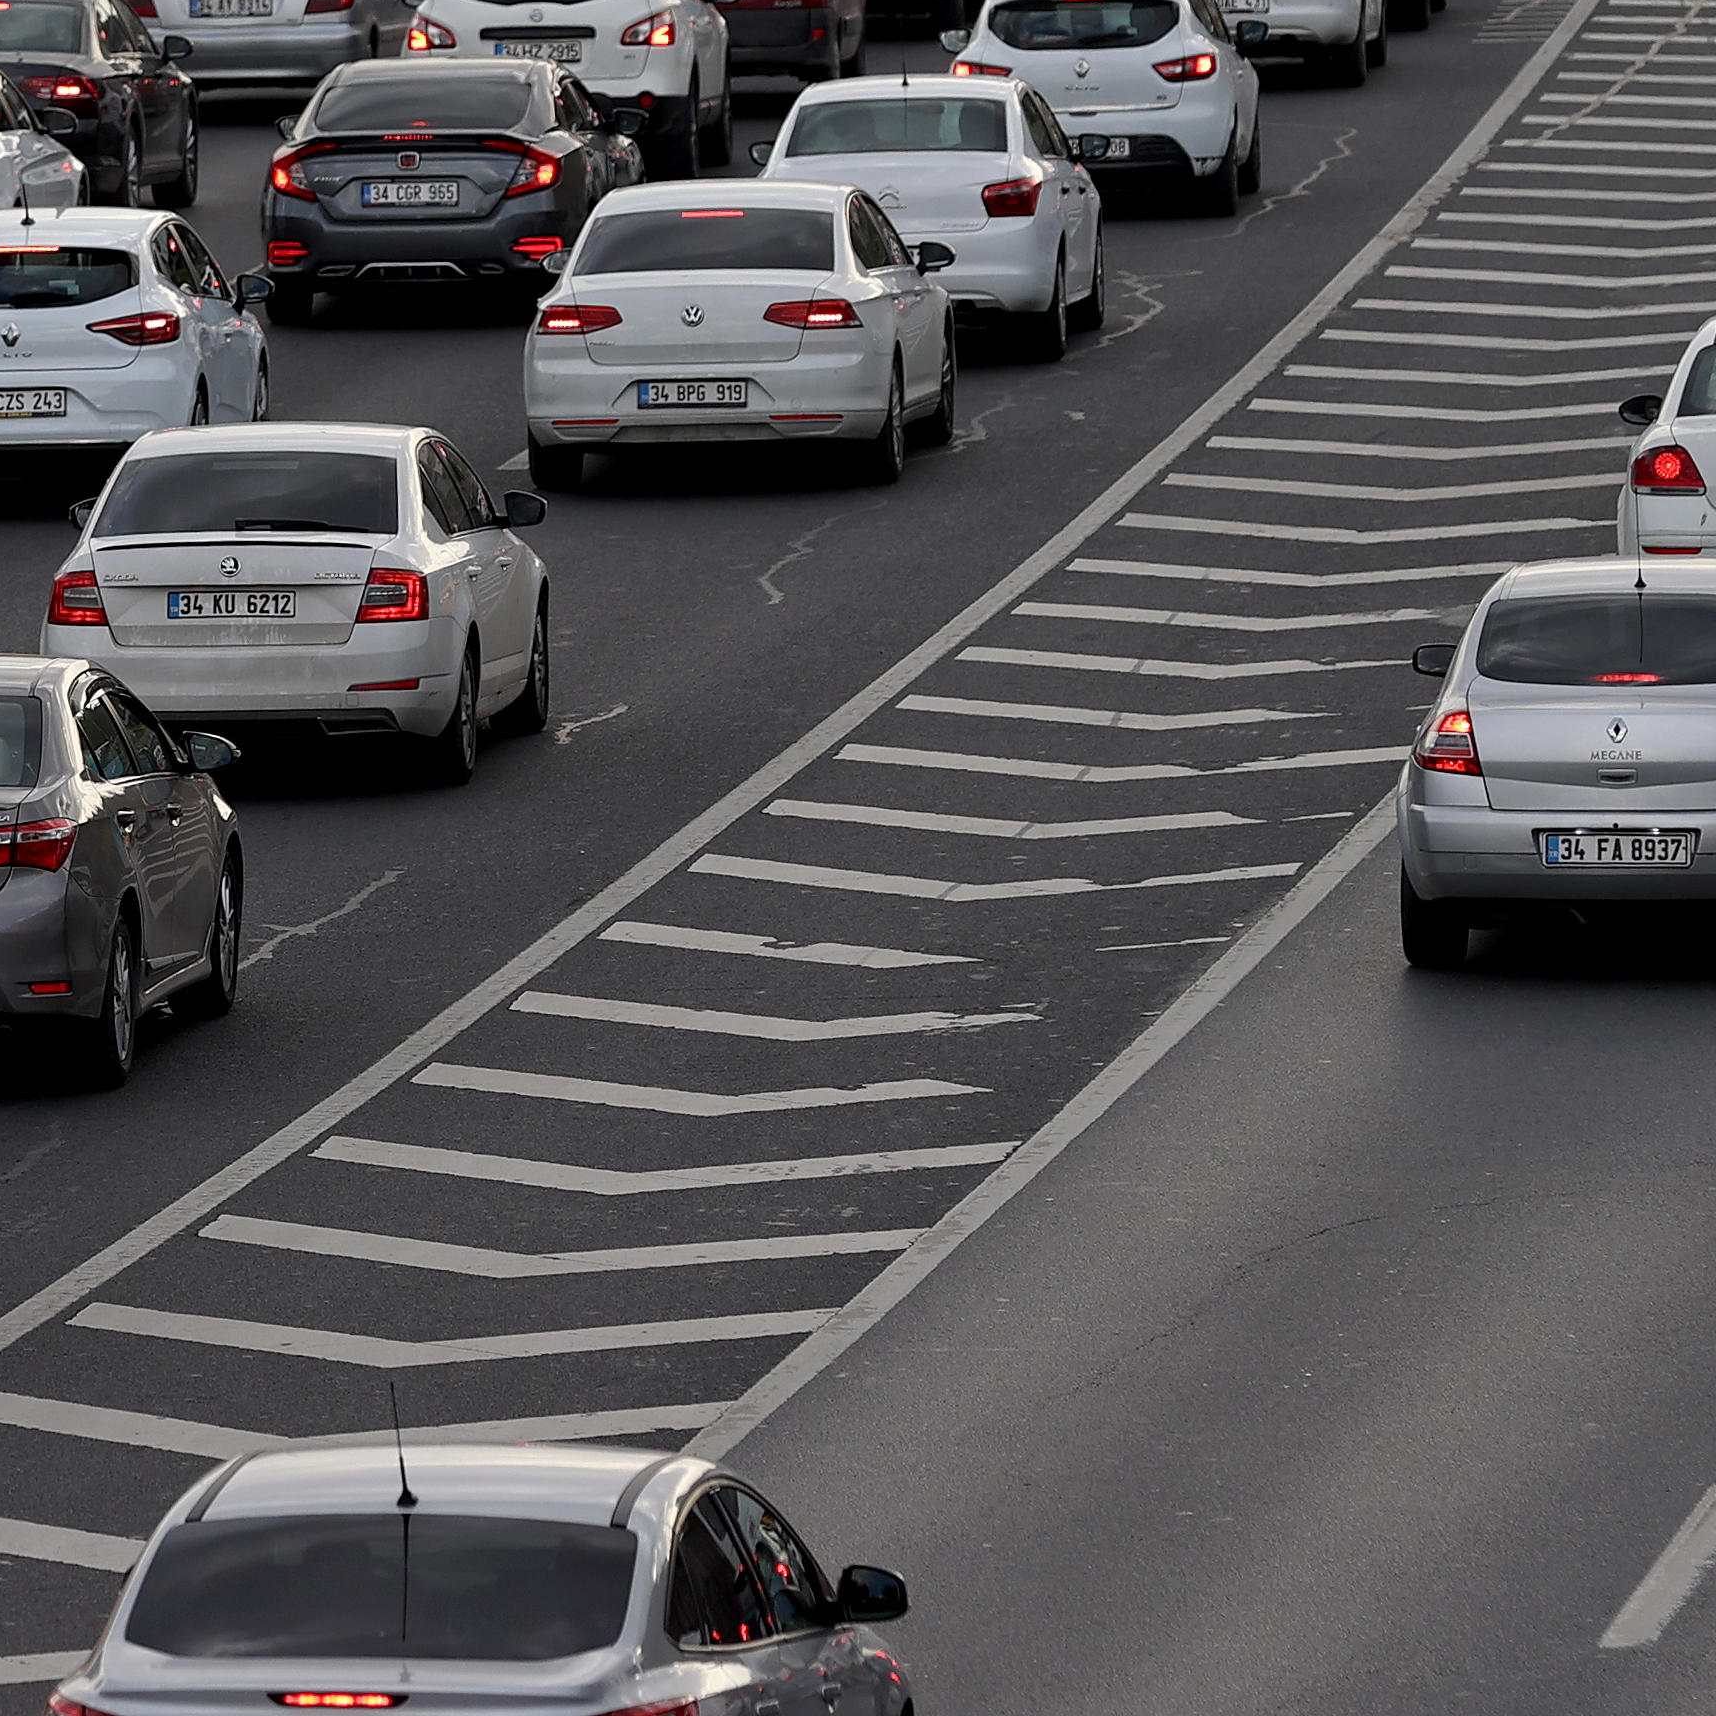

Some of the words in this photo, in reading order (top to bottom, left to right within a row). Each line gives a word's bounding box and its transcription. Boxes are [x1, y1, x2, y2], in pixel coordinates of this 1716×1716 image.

[548, 41, 580, 59] 2915
[371, 184, 386, 201] 34
[395, 183, 422, 201] CGR
[428, 183, 454, 201] 965
[33, 390, 63, 411] 243
[650, 385, 670, 402] 34
[677, 385, 706, 402] BPG
[716, 384, 743, 402] 919
[179, 594, 204, 615] 34
[212, 594, 236, 615] KU
[246, 593, 291, 615] 6212
[1590, 750, 1643, 761] MEGANE
[1559, 838, 1585, 862] 34
[1596, 838, 1623, 862] FA
[1630, 838, 1683, 862] 8937
